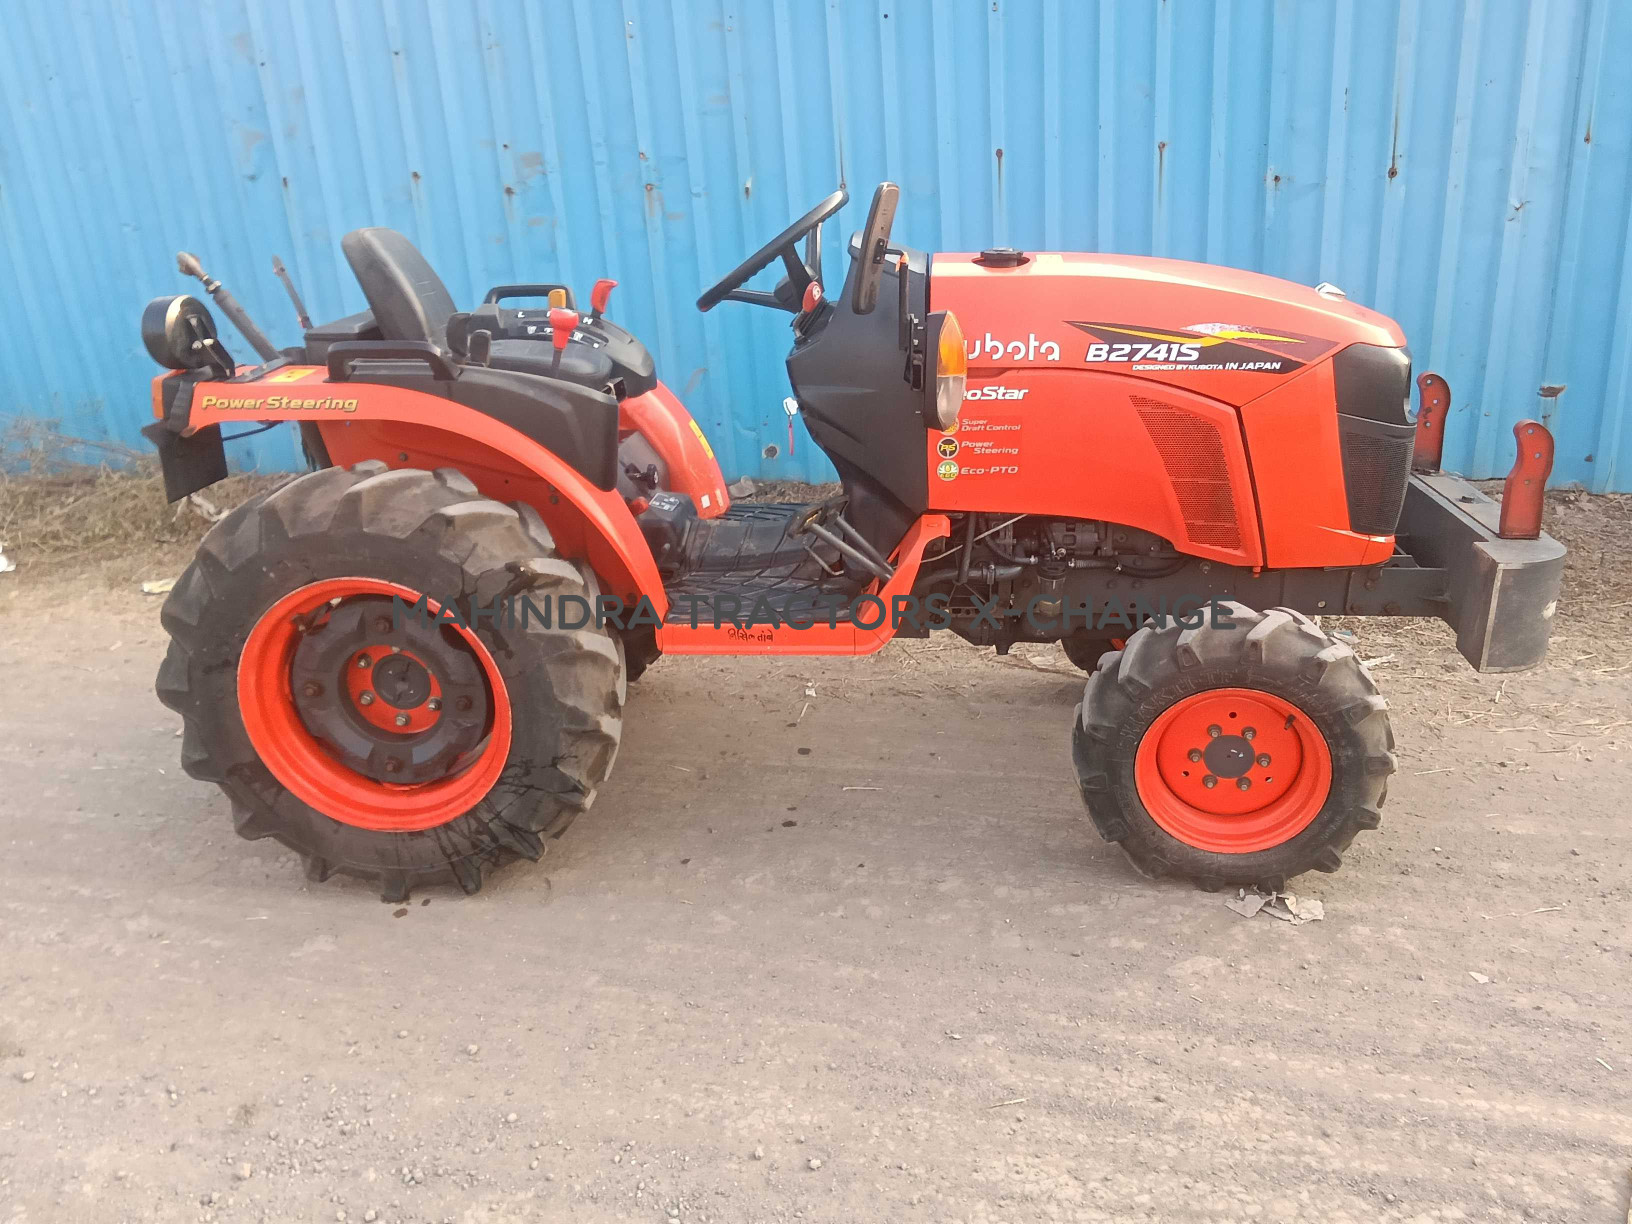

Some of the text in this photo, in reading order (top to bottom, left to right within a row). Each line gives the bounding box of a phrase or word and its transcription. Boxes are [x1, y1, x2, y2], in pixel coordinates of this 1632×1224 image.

[963, 332, 1061, 361] ubota
[1085, 343, 1200, 362] B2741S
[1224, 362, 1238, 370] IN
[1239, 362, 1282, 370] JAPAN
[963, 386, 1029, 401] oStar
[201, 396, 358, 412] Power Steering
[962, 418, 988, 426] Super
[960, 466, 1019, 475] Eco-PTO
